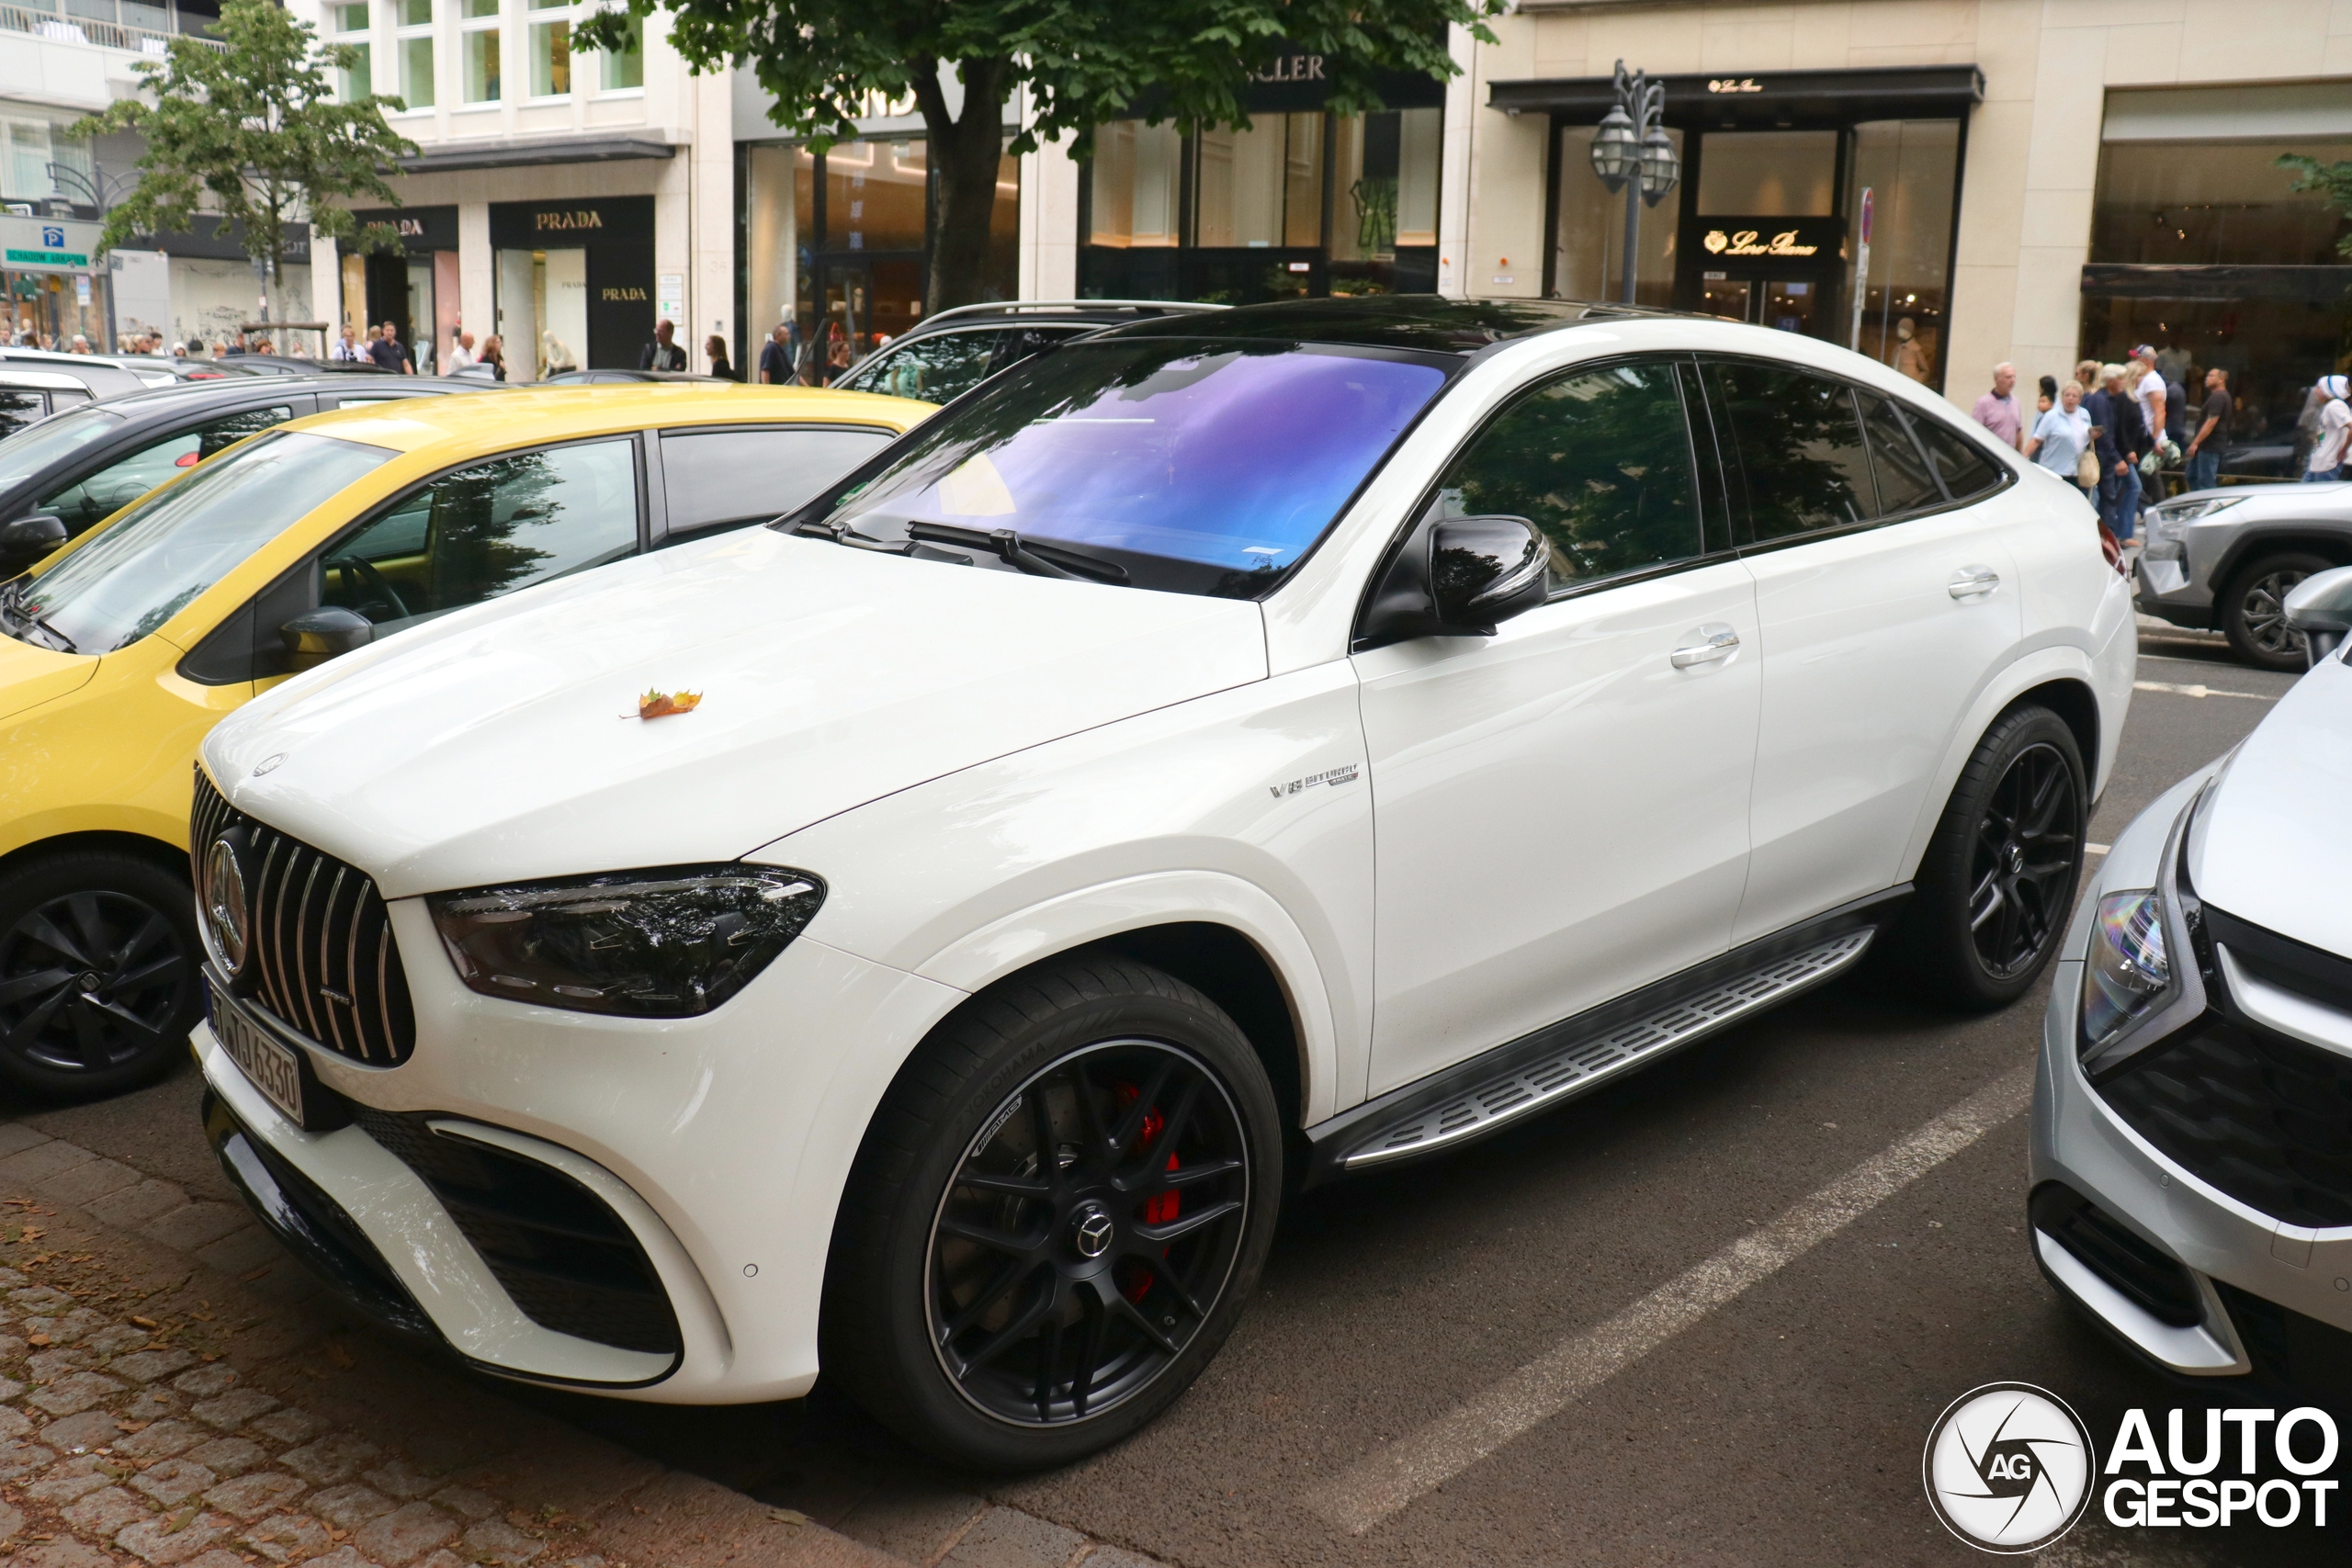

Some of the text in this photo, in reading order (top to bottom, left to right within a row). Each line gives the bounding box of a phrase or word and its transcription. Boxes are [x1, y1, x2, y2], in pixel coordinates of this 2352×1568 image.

[537, 210, 603, 230] PRADA
[1724, 230, 1818, 256] Loro Piana
[6, 250, 87, 265] SCHADOW ARKADEN
[602, 288, 648, 301] PRADA
[1305, 763, 1358, 784] BITURBO
[965, 1042, 1046, 1115] YOKOHAMA
